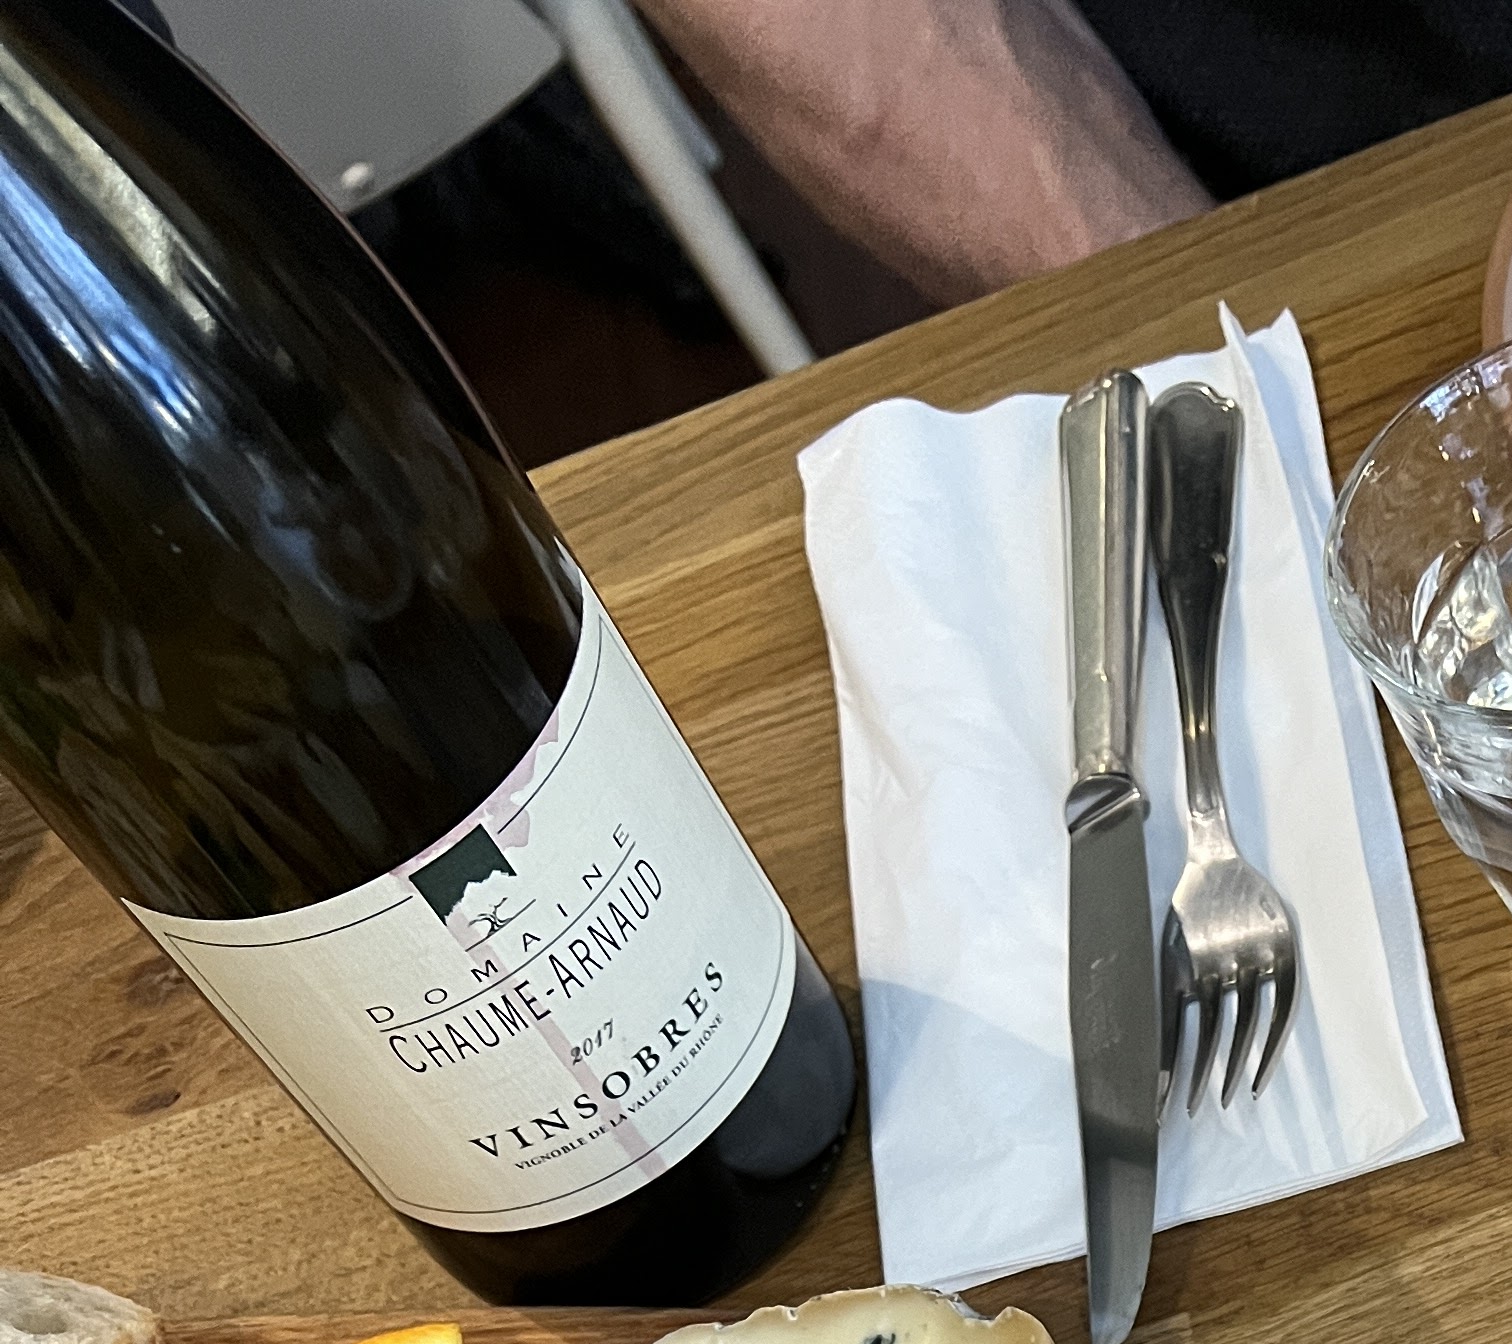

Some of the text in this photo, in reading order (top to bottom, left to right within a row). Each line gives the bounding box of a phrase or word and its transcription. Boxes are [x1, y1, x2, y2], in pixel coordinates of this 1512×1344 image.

[365, 823, 630, 1024] DOMAINE
[388, 859, 662, 1073] CHAUME-ARNAUD
[468, 962, 724, 1158] VINSOBRES
[514, 1013, 724, 1170] VIGNOBLE DE LA VALLÉE DU RHÔNE
[570, 1018, 614, 1065] 2017
